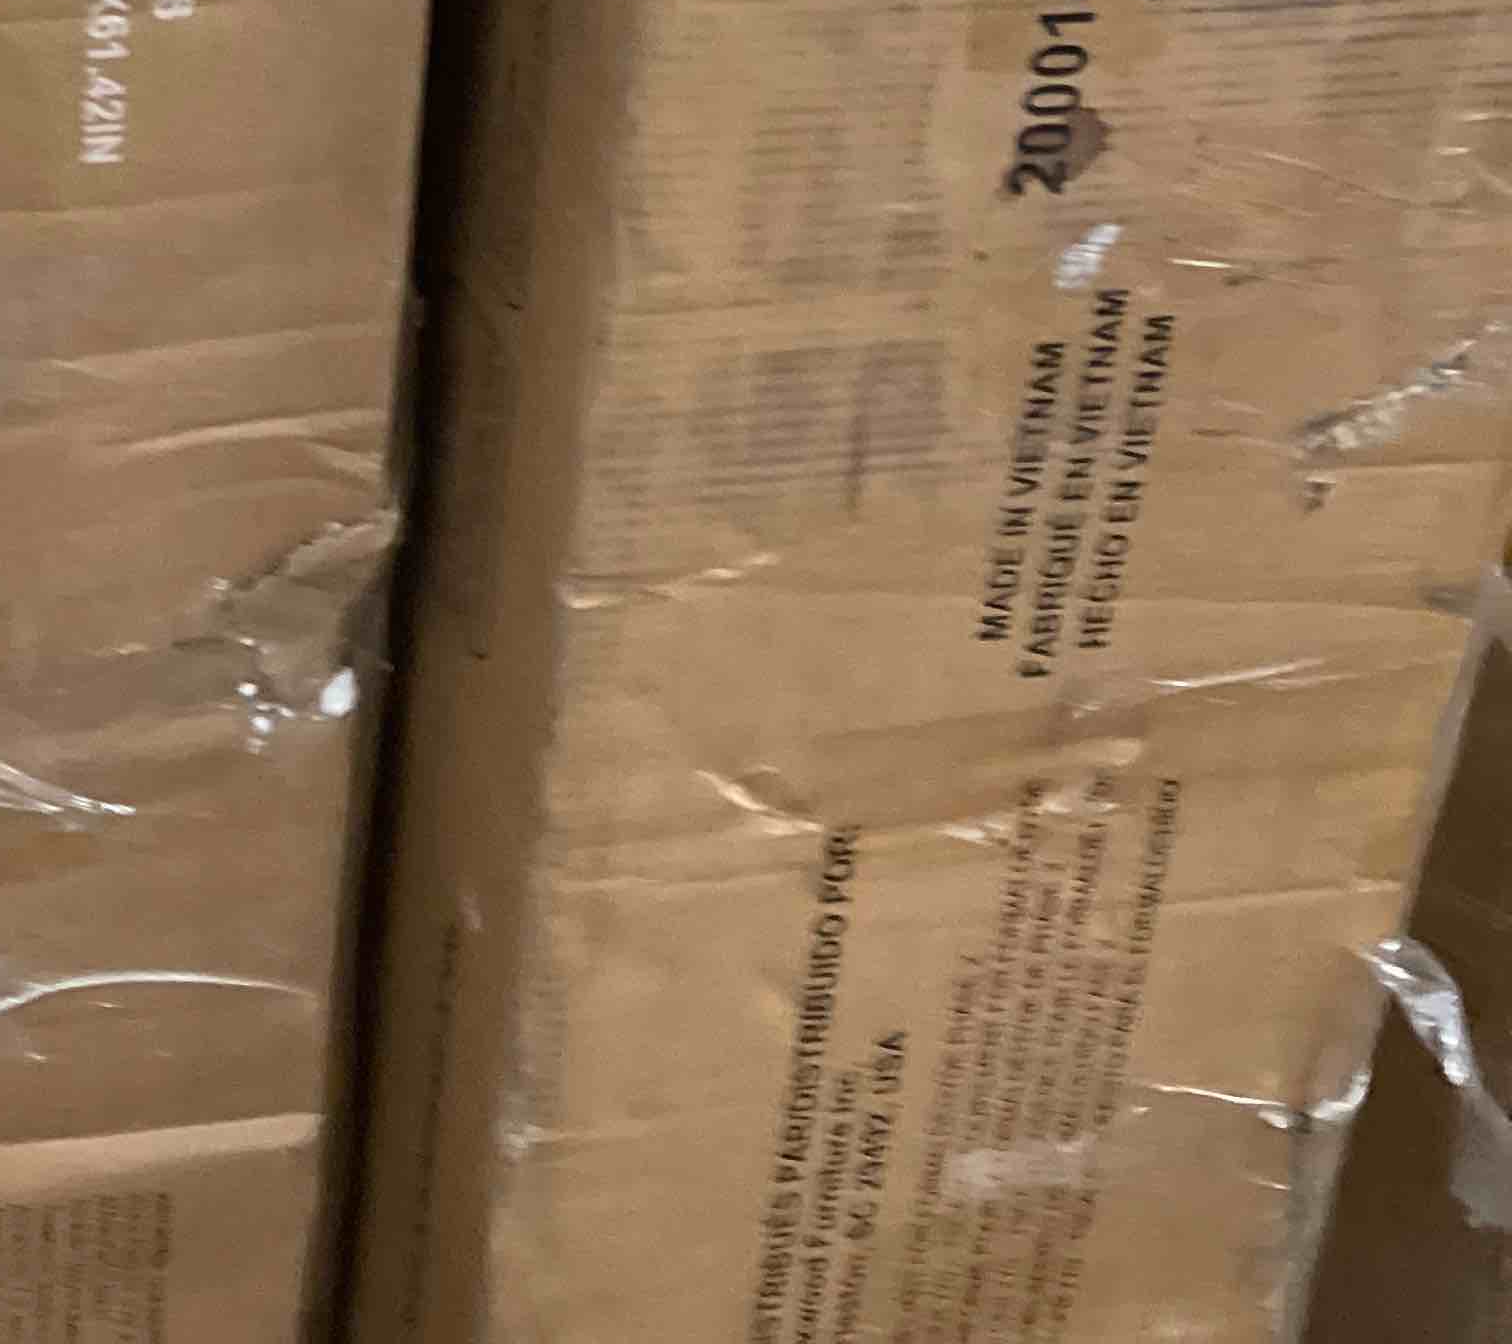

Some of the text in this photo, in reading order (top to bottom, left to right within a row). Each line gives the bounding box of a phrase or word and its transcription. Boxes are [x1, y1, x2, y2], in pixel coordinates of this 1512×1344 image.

[1057, 456, 1096, 502] EN
[1066, 288, 1130, 444] VIETNAM
[976, 342, 1067, 641] MADE IN VIETNAM
[1076, 314, 1177, 649] HECHO EN VIETNAM
